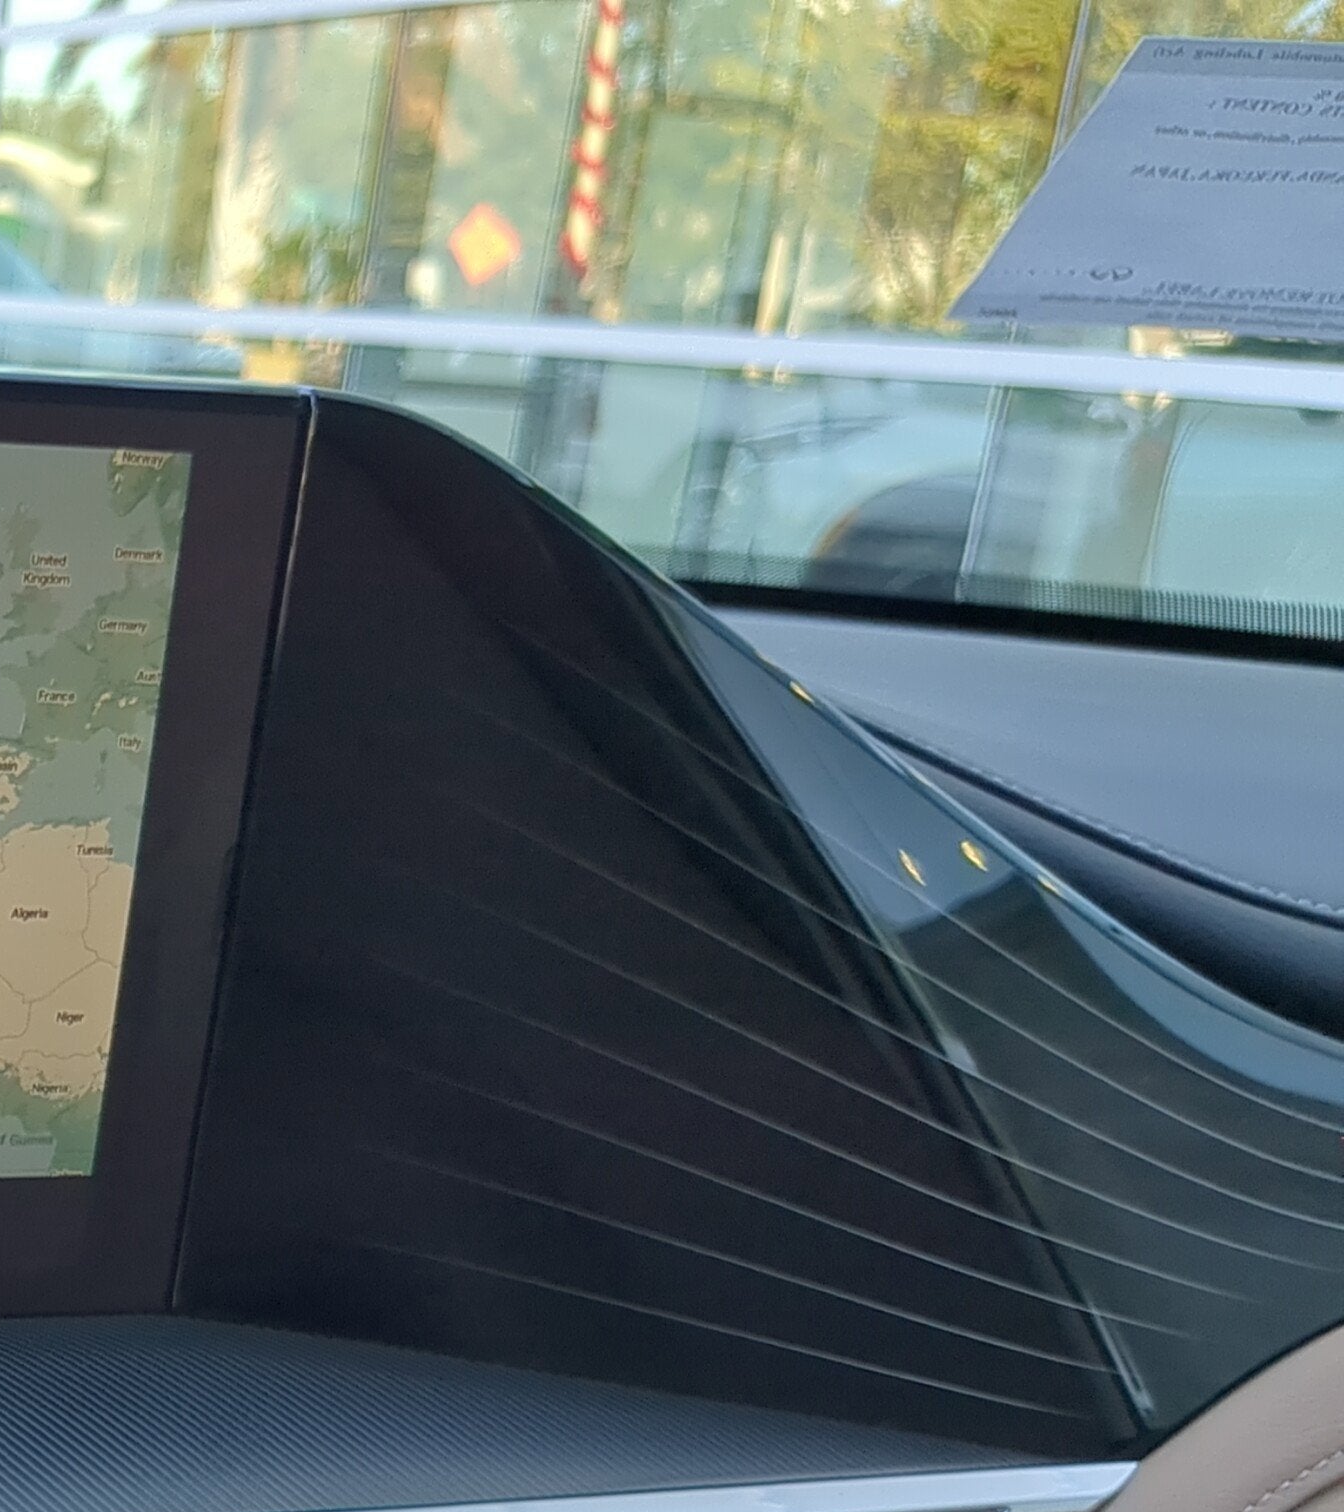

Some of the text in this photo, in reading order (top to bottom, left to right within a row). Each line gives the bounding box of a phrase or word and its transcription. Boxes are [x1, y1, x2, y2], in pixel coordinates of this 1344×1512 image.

[121, 451, 163, 468] Norway
[115, 547, 163, 560] Denmark
[31, 554, 67, 568] United
[23, 572, 70, 587] Kingdom
[98, 618, 148, 634] Germany
[38, 690, 75, 702] France
[118, 736, 142, 751] Italy
[76, 844, 114, 857] Tunisia
[11, 907, 49, 921] Algeria
[56, 1011, 85, 1025] Niger
[32, 1081, 69, 1095] Nigeria
